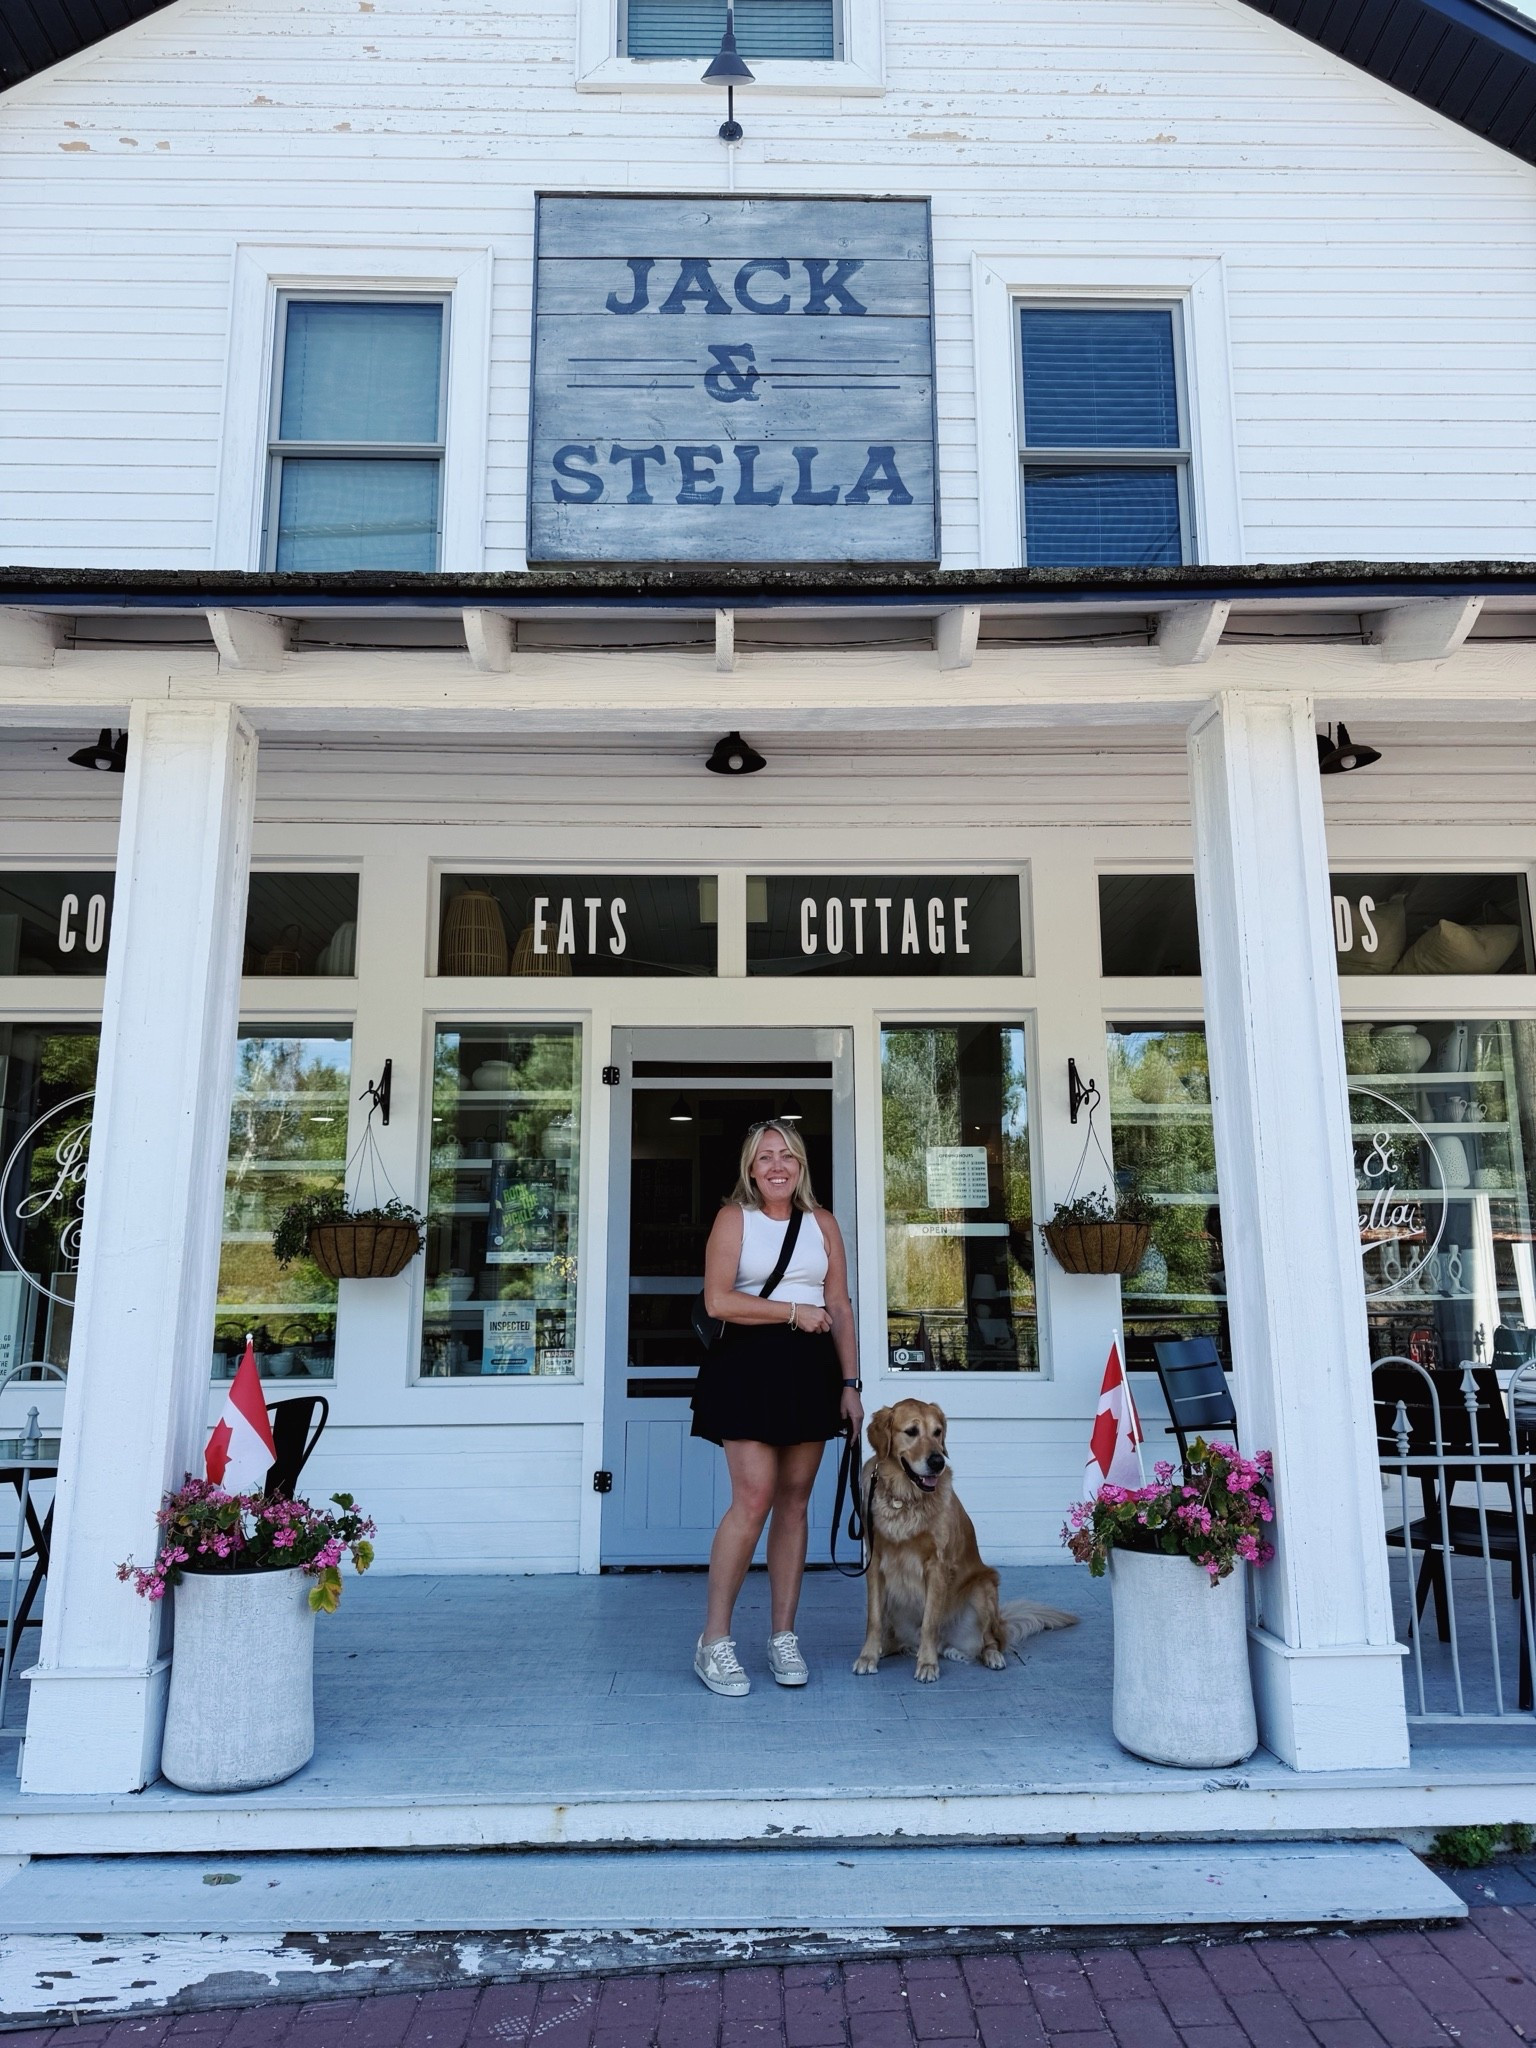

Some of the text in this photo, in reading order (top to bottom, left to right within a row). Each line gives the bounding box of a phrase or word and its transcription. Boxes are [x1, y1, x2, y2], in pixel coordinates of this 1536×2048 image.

[605, 257, 868, 315] JACK
[703, 343, 761, 403] &
[551, 445, 914, 506] STELLA
[533, 897, 627, 955] EATS
[800, 897, 970, 955] COTTAGE
[1363, 1131, 1399, 1178] &
[503, 1184, 528, 1202] ROCK
[521, 1193, 539, 1209] THE
[502, 1208, 535, 1228] PICKLE
[922, 1226, 948, 1234] OPEN
[489, 1321, 531, 1331] INSPECTED
